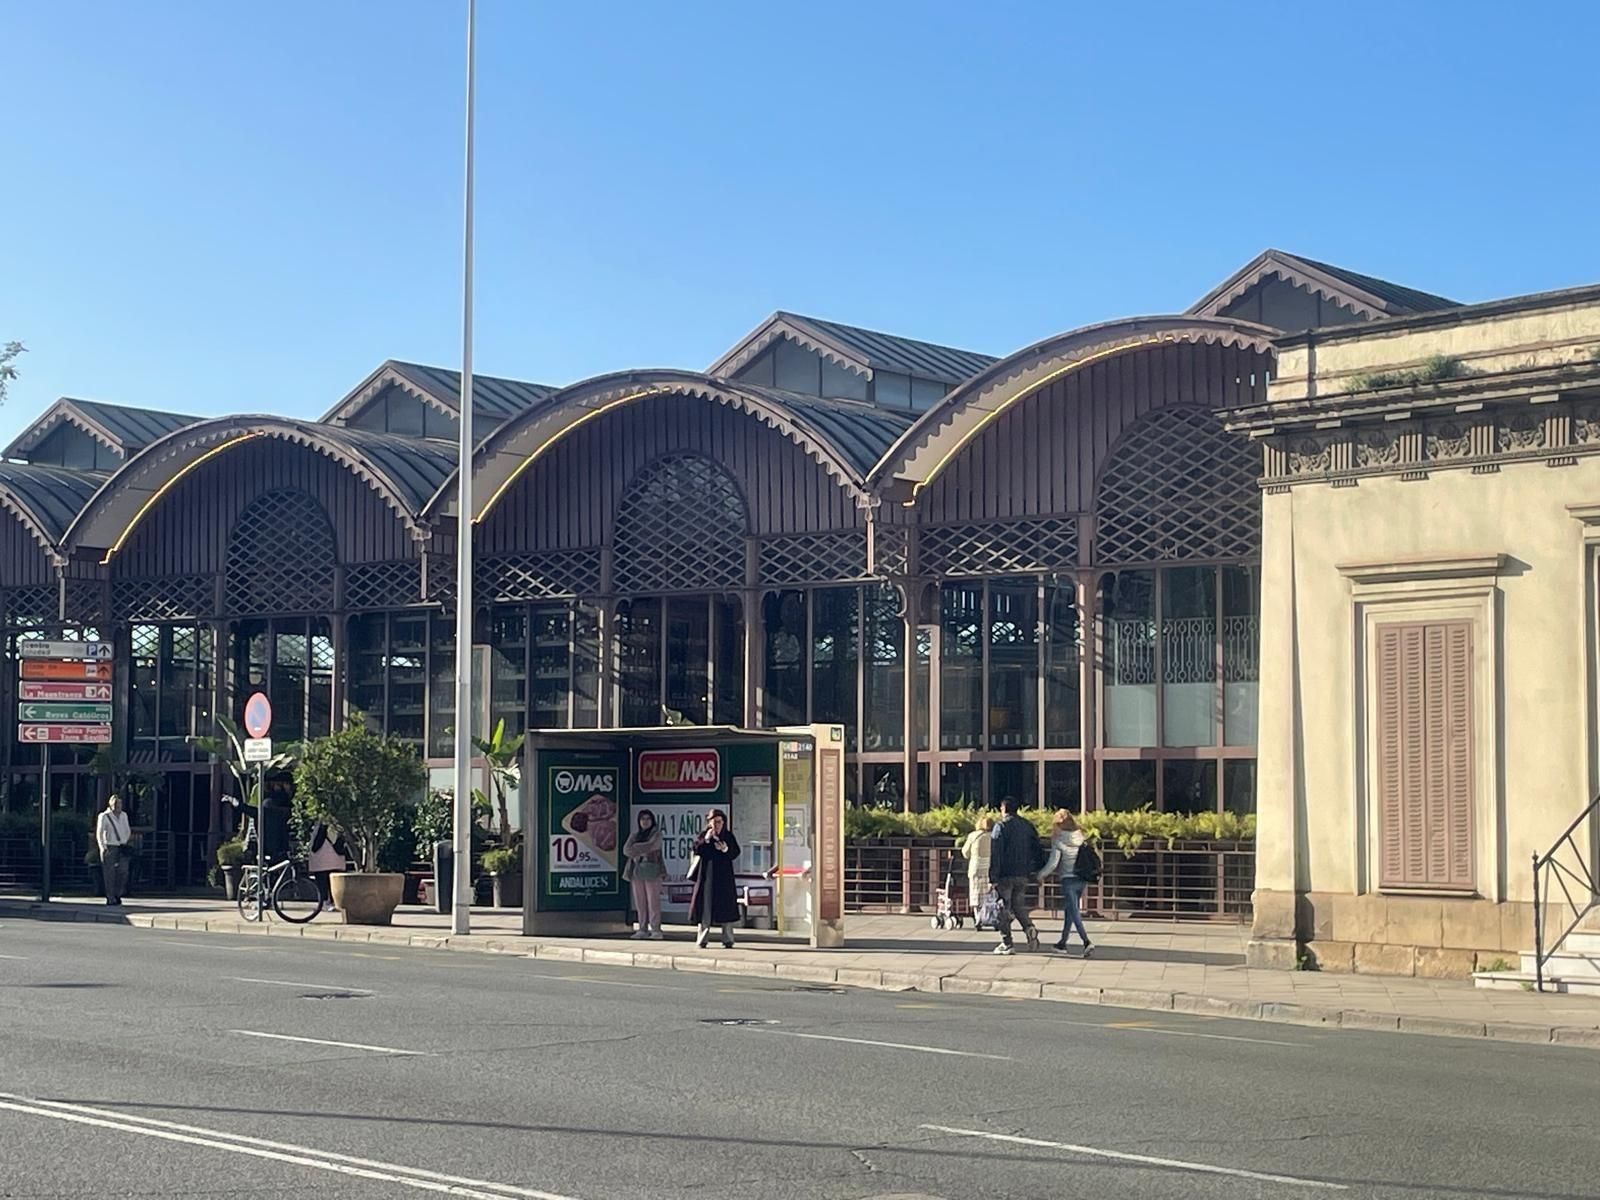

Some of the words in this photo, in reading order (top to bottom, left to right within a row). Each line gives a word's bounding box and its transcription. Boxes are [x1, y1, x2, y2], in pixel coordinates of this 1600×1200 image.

[24, 690, 34, 698] La
[642, 760, 678, 783] CLUB
[679, 759, 715, 782] MAS
[573, 774, 613, 792] MAS
[670, 814, 675, 835] 1
[679, 810, 702, 835] AÑO
[662, 837, 676, 859] TE
